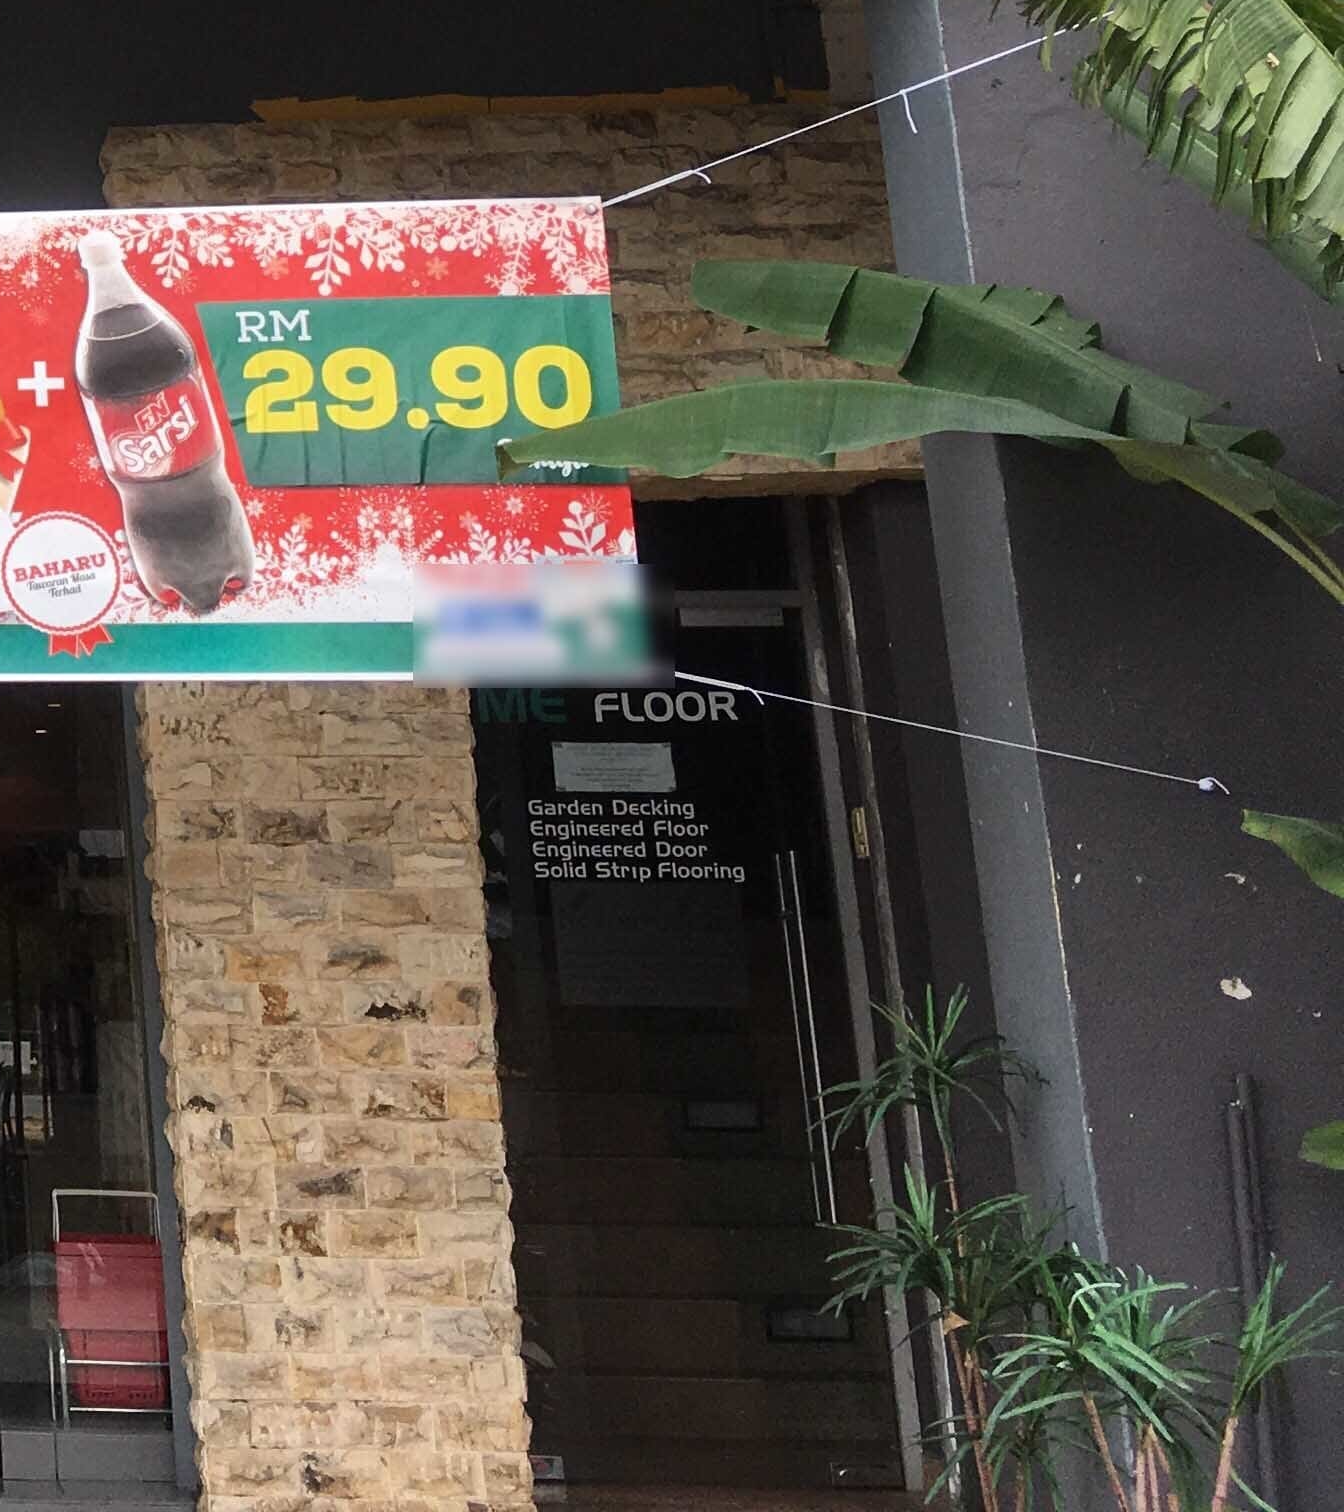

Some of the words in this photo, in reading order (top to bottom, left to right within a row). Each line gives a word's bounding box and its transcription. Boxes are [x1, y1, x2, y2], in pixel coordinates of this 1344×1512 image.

[236, 310, 312, 343] RM
[242, 344, 592, 433] 29.90
[118, 394, 198, 473] Sarsi
[13, 553, 106, 583] BAHARU
[70, 572, 96, 583] Masa
[48, 584, 82, 598] Terhad
[476, 688, 567, 723] ME
[594, 691, 739, 723] FLOOR
[528, 800, 604, 816] Garden
[612, 800, 696, 819] Decking
[530, 821, 644, 840] Engineered
[654, 821, 710, 837] Floor
[532, 842, 646, 860] Engineered
[656, 842, 708, 858] Door
[534, 862, 587, 879] Solid
[595, 862, 652, 883] Strip
[658, 862, 746, 882] Flooring
